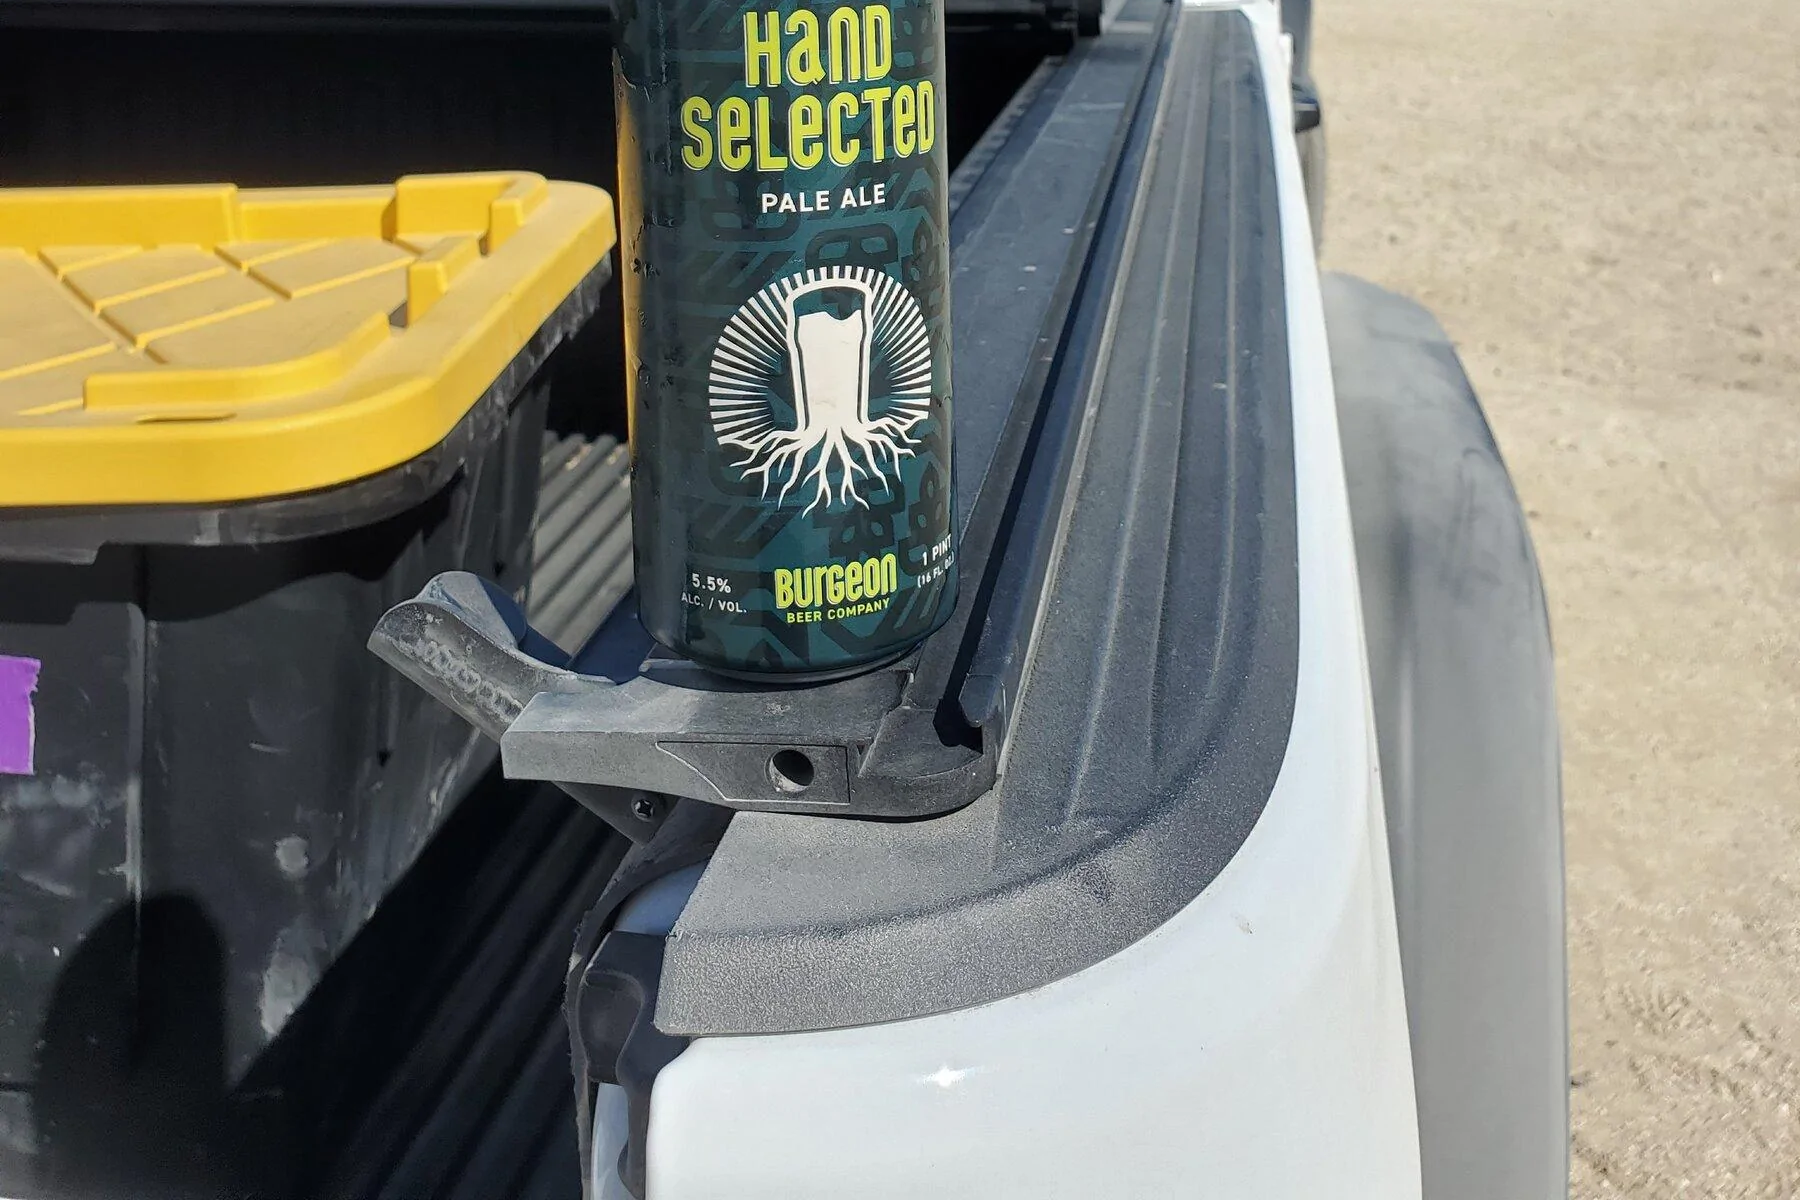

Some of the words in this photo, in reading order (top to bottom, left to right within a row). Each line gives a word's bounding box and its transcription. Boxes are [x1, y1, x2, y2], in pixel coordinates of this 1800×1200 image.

[761, 190, 831, 214] PALE
[840, 183, 886, 209] ALE
[922, 551, 928, 566] 1
[932, 533, 952, 561] PINT
[692, 572, 732, 593] 5.5%
[917, 572, 932, 588] (16
[681, 591, 705, 607] ALC.
[718, 599, 747, 613] VOL.
[786, 610, 822, 623] BEER
[827, 597, 890, 620] COMPANY
